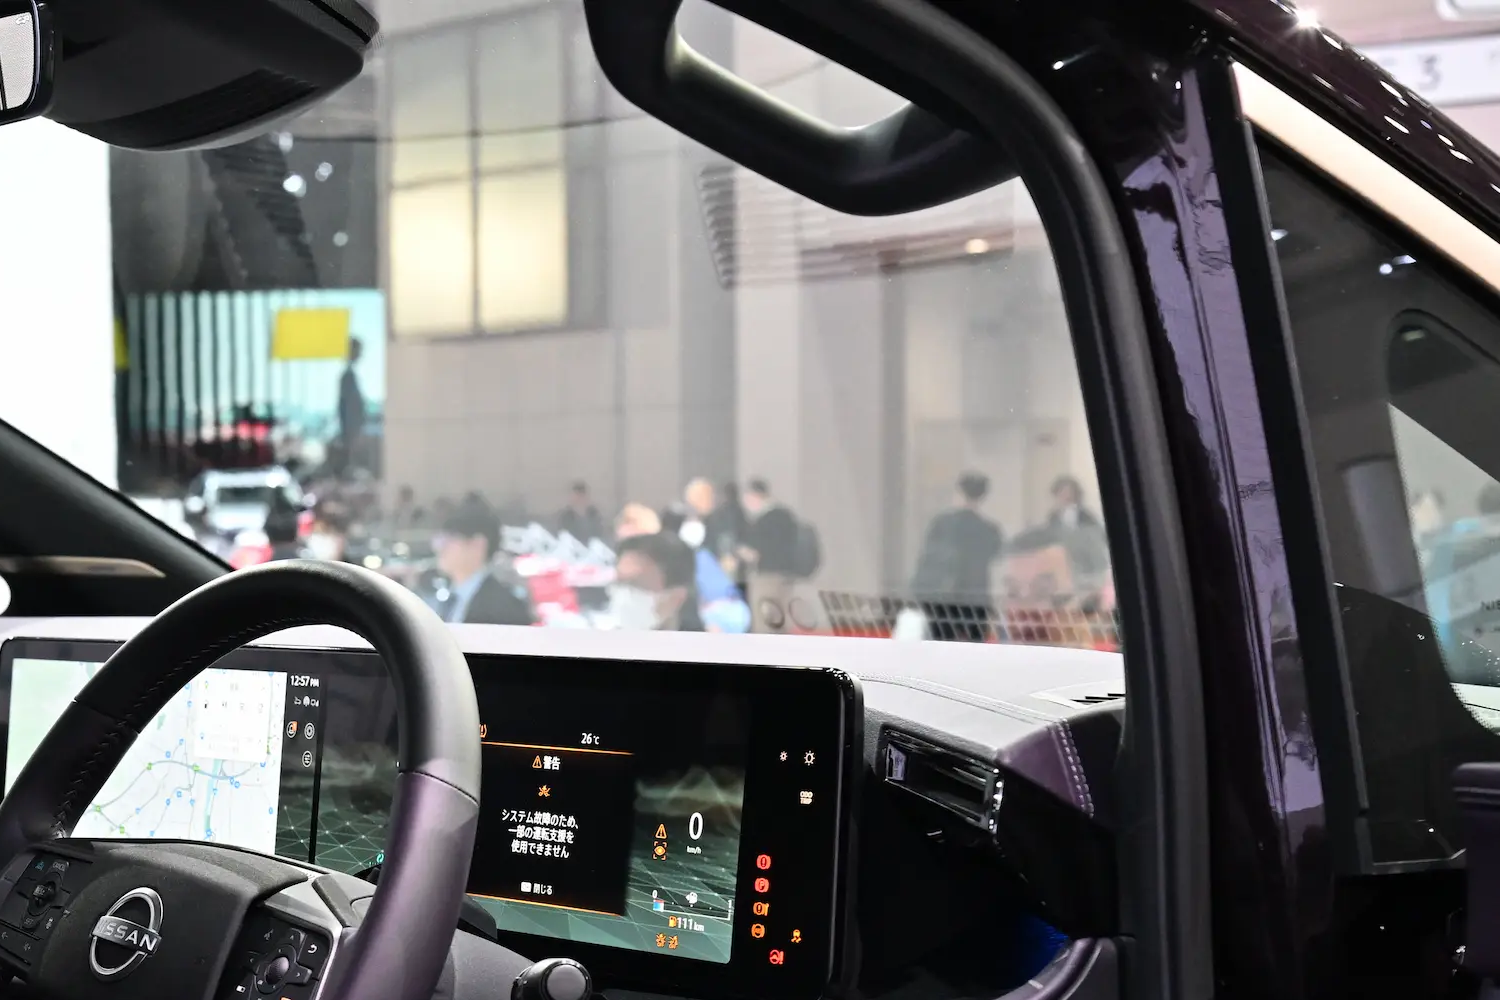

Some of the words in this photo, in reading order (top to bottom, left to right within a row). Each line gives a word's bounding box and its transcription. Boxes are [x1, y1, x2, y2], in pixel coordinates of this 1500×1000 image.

[290, 675, 310, 686] 12:57
[310, 678, 320, 687] PM
[543, 756, 561, 770] 警告
[502, 809, 578, 829] システム故障のため、
[689, 812, 703, 840] 0
[508, 825, 575, 844] 一部の運転支援を
[511, 839, 570, 859] 使用できません
[686, 845, 702, 855] km/h
[533, 882, 553, 896] 閉じる
[652, 889, 658, 899] 0
[677, 917, 694, 931] 111
[693, 921, 705, 932] km
[94, 919, 158, 951] NISSAN
